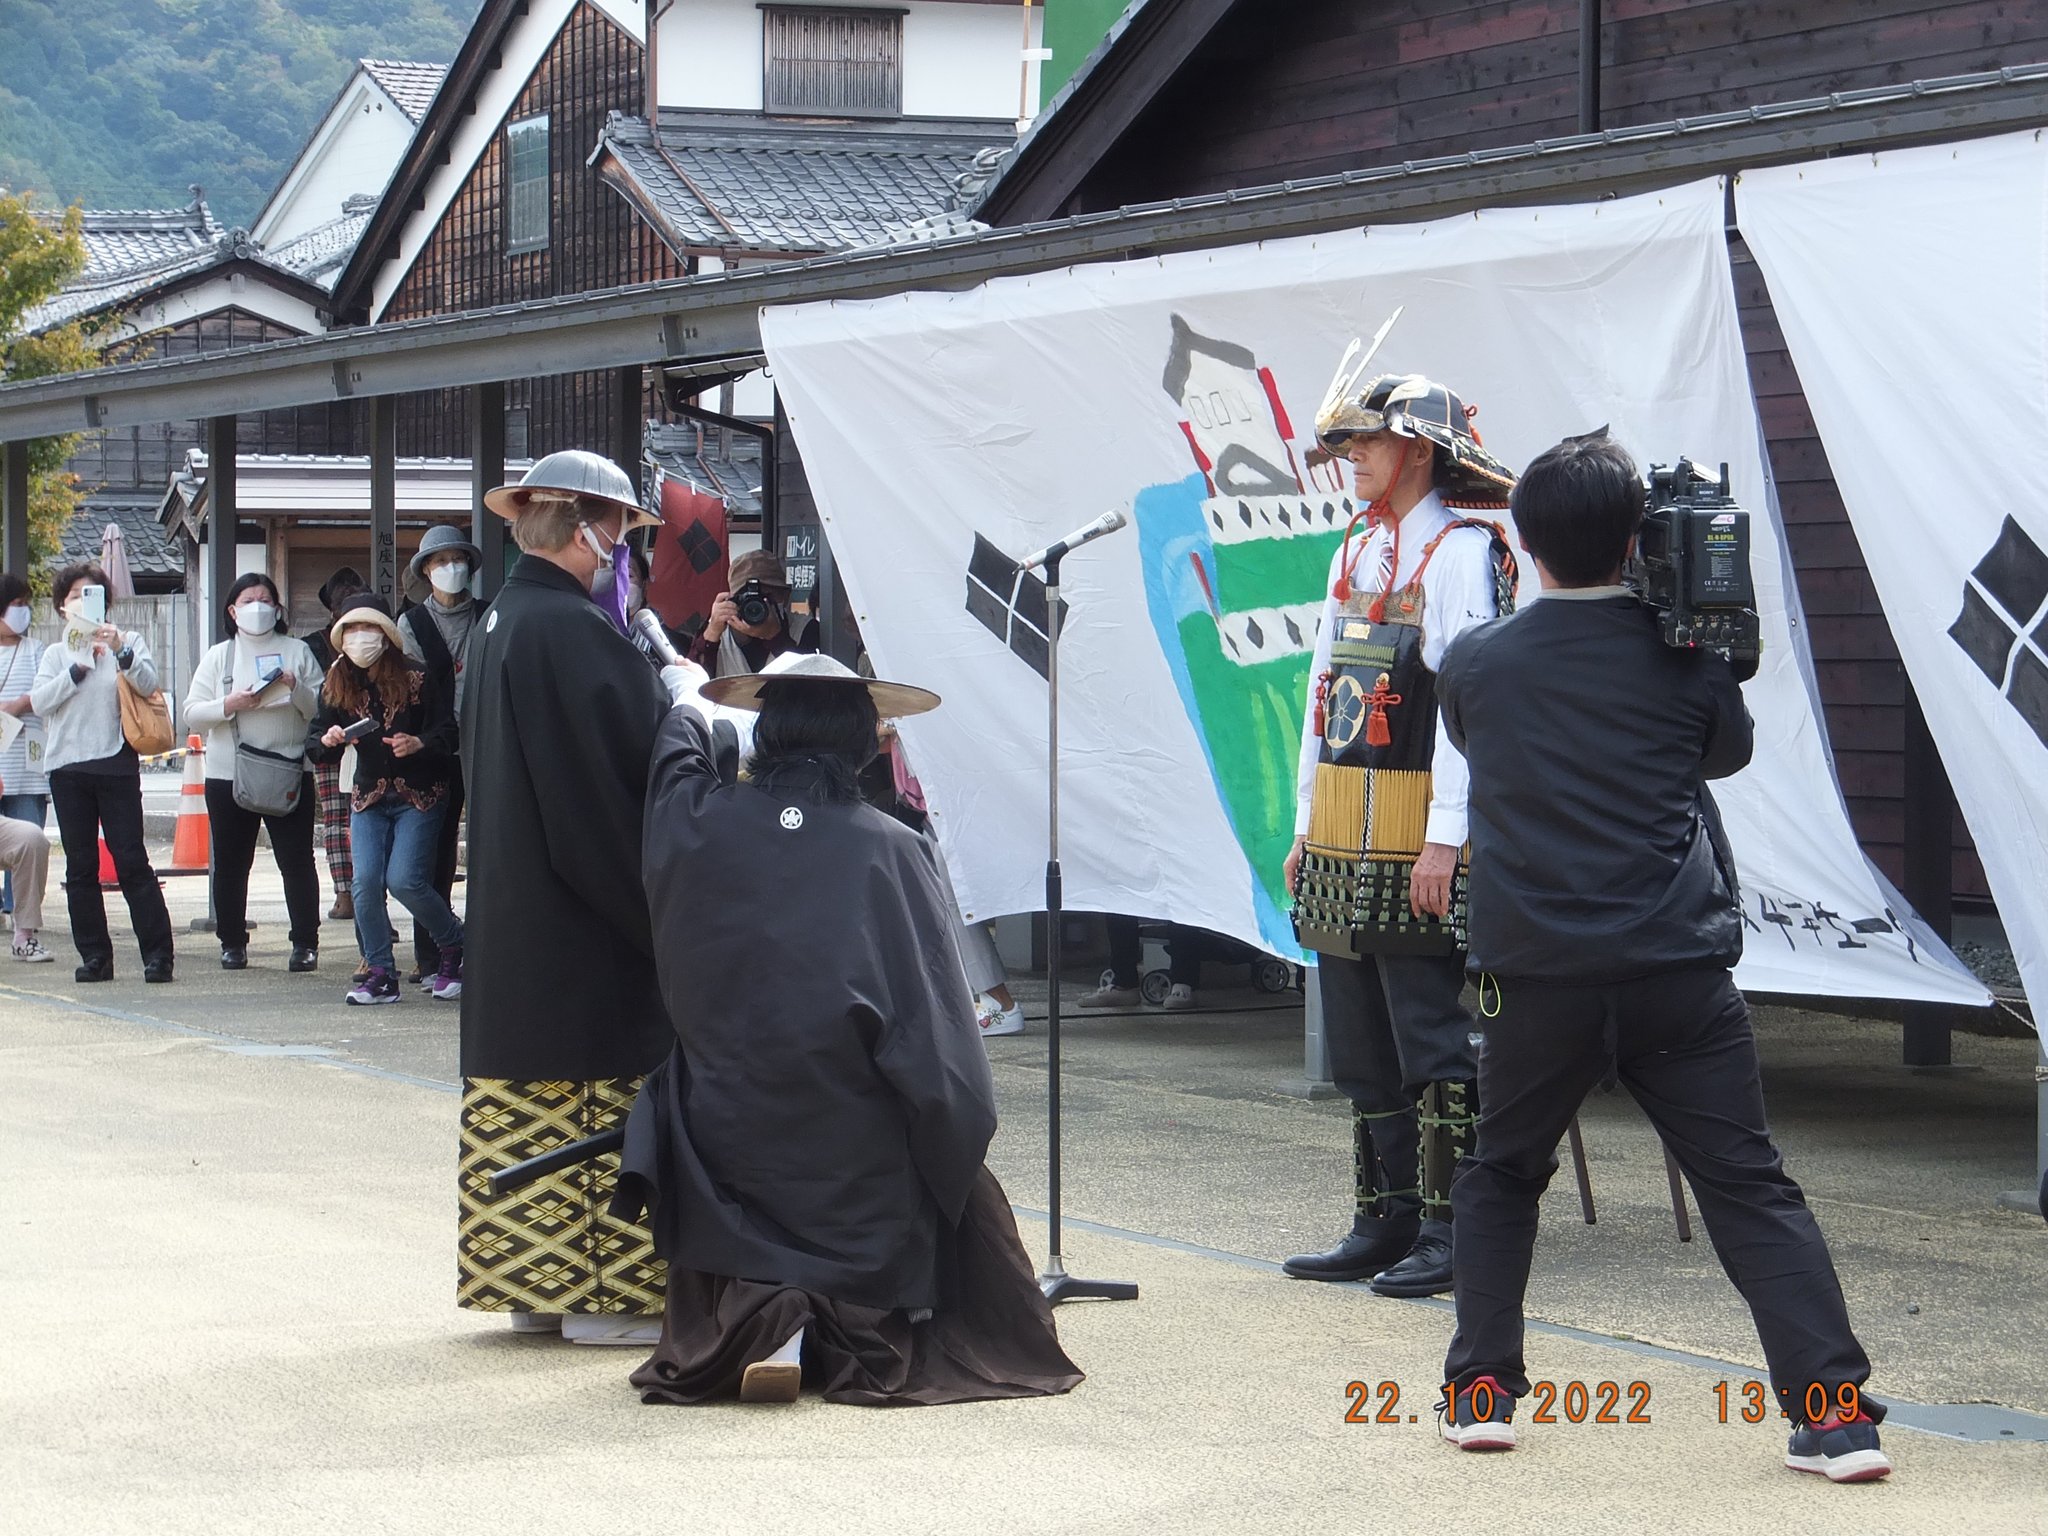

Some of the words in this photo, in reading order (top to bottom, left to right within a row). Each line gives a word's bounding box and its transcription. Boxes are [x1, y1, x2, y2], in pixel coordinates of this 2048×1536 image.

[378, 531, 393, 594] 旭座入口
[795, 535, 815, 557] トイレ
